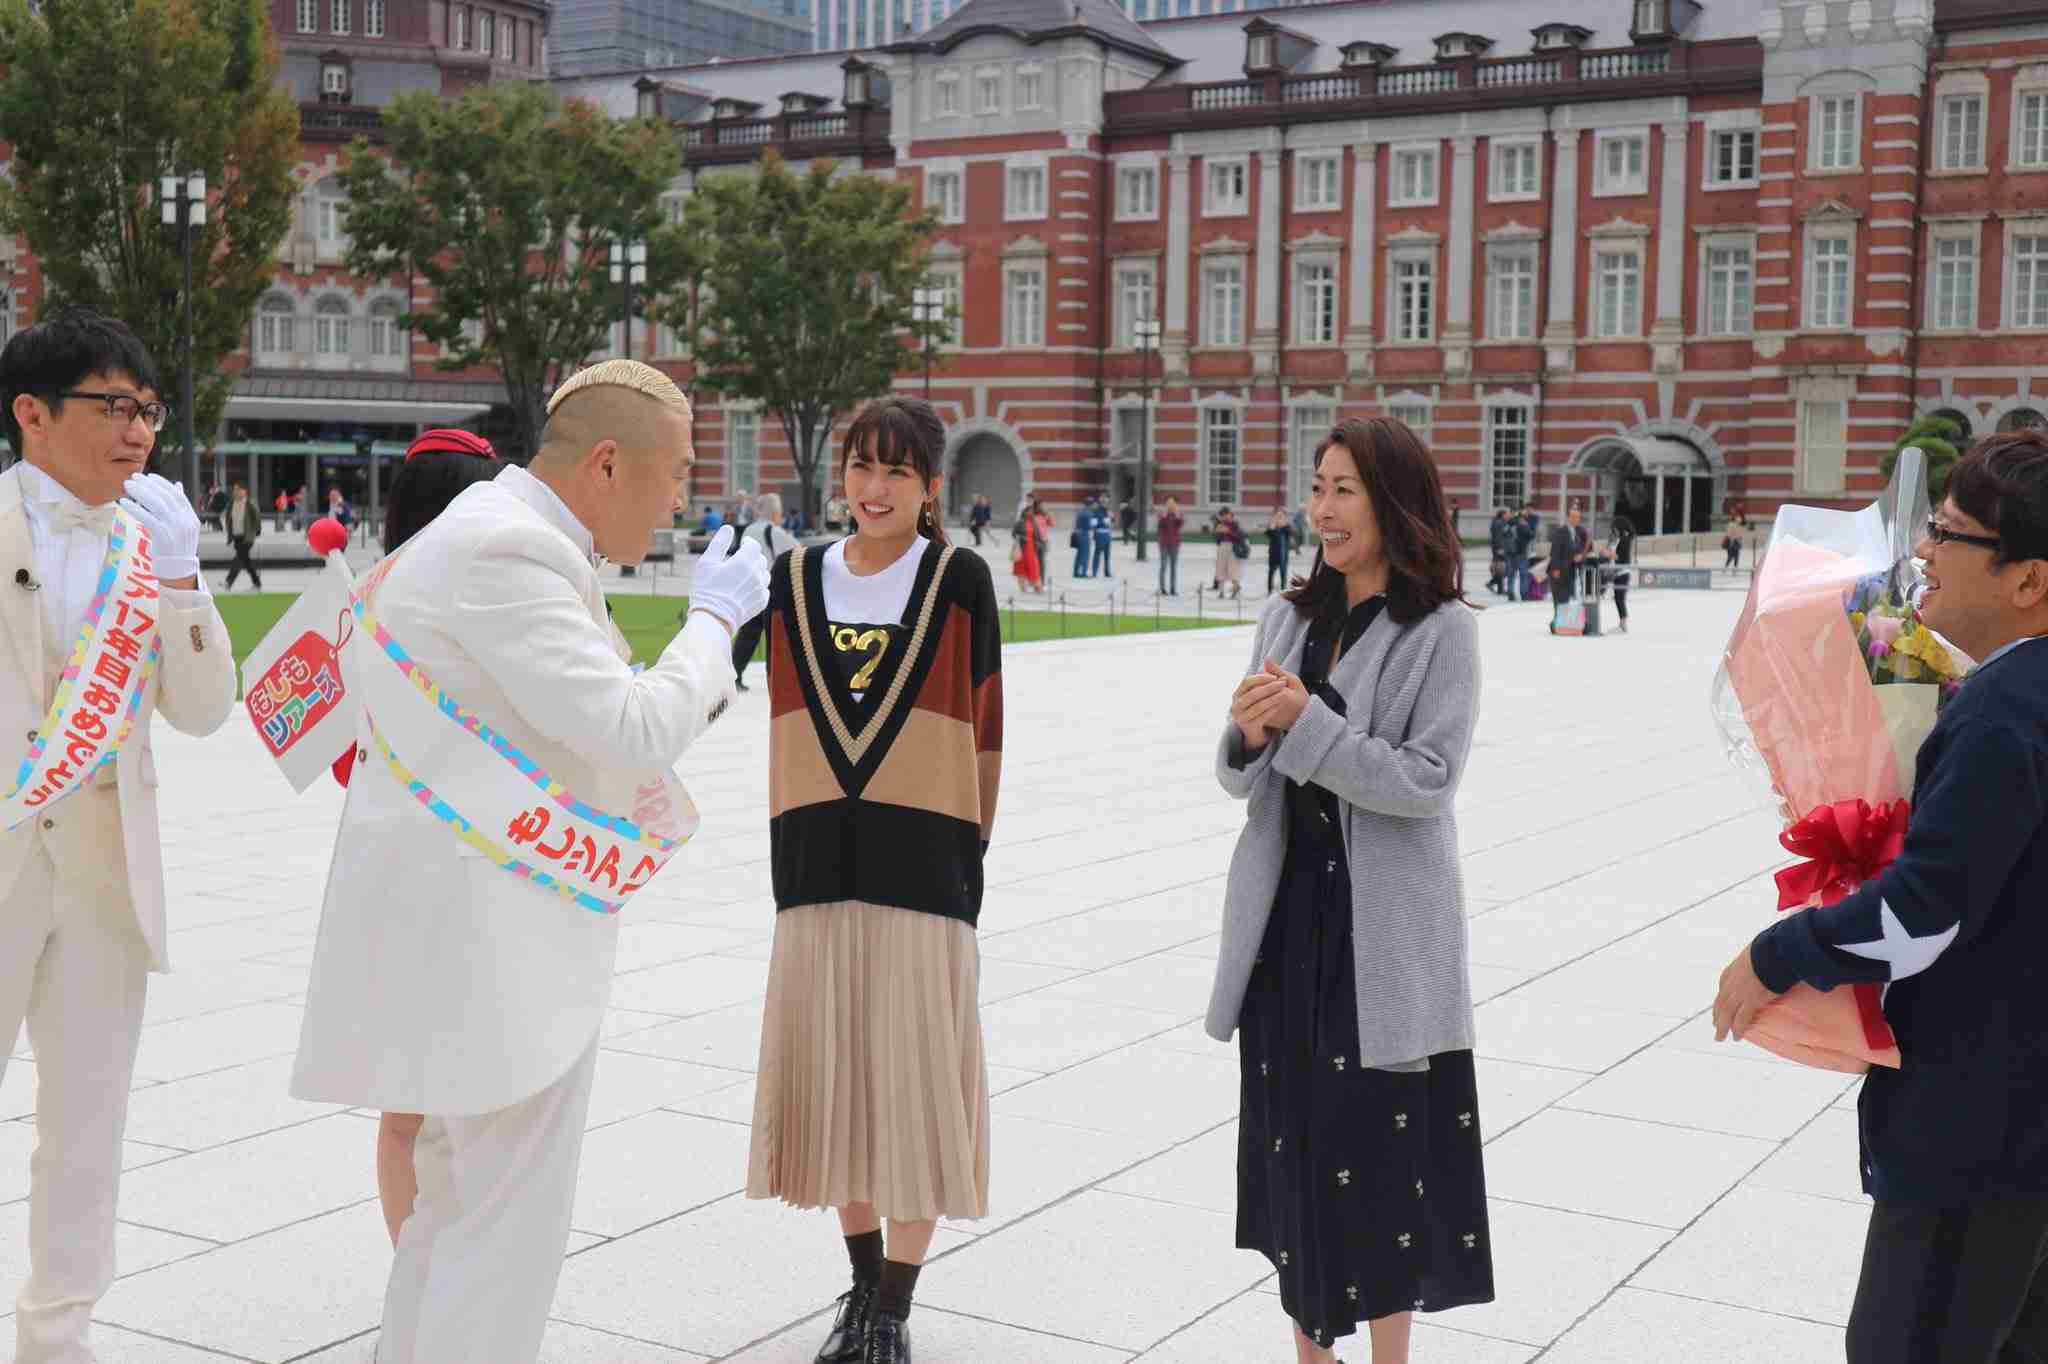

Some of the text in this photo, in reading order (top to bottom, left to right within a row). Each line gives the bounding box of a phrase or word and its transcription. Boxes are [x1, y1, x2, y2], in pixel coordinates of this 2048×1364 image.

[250, 656, 311, 718] もしも
[263, 665, 342, 748] ツアーズ
